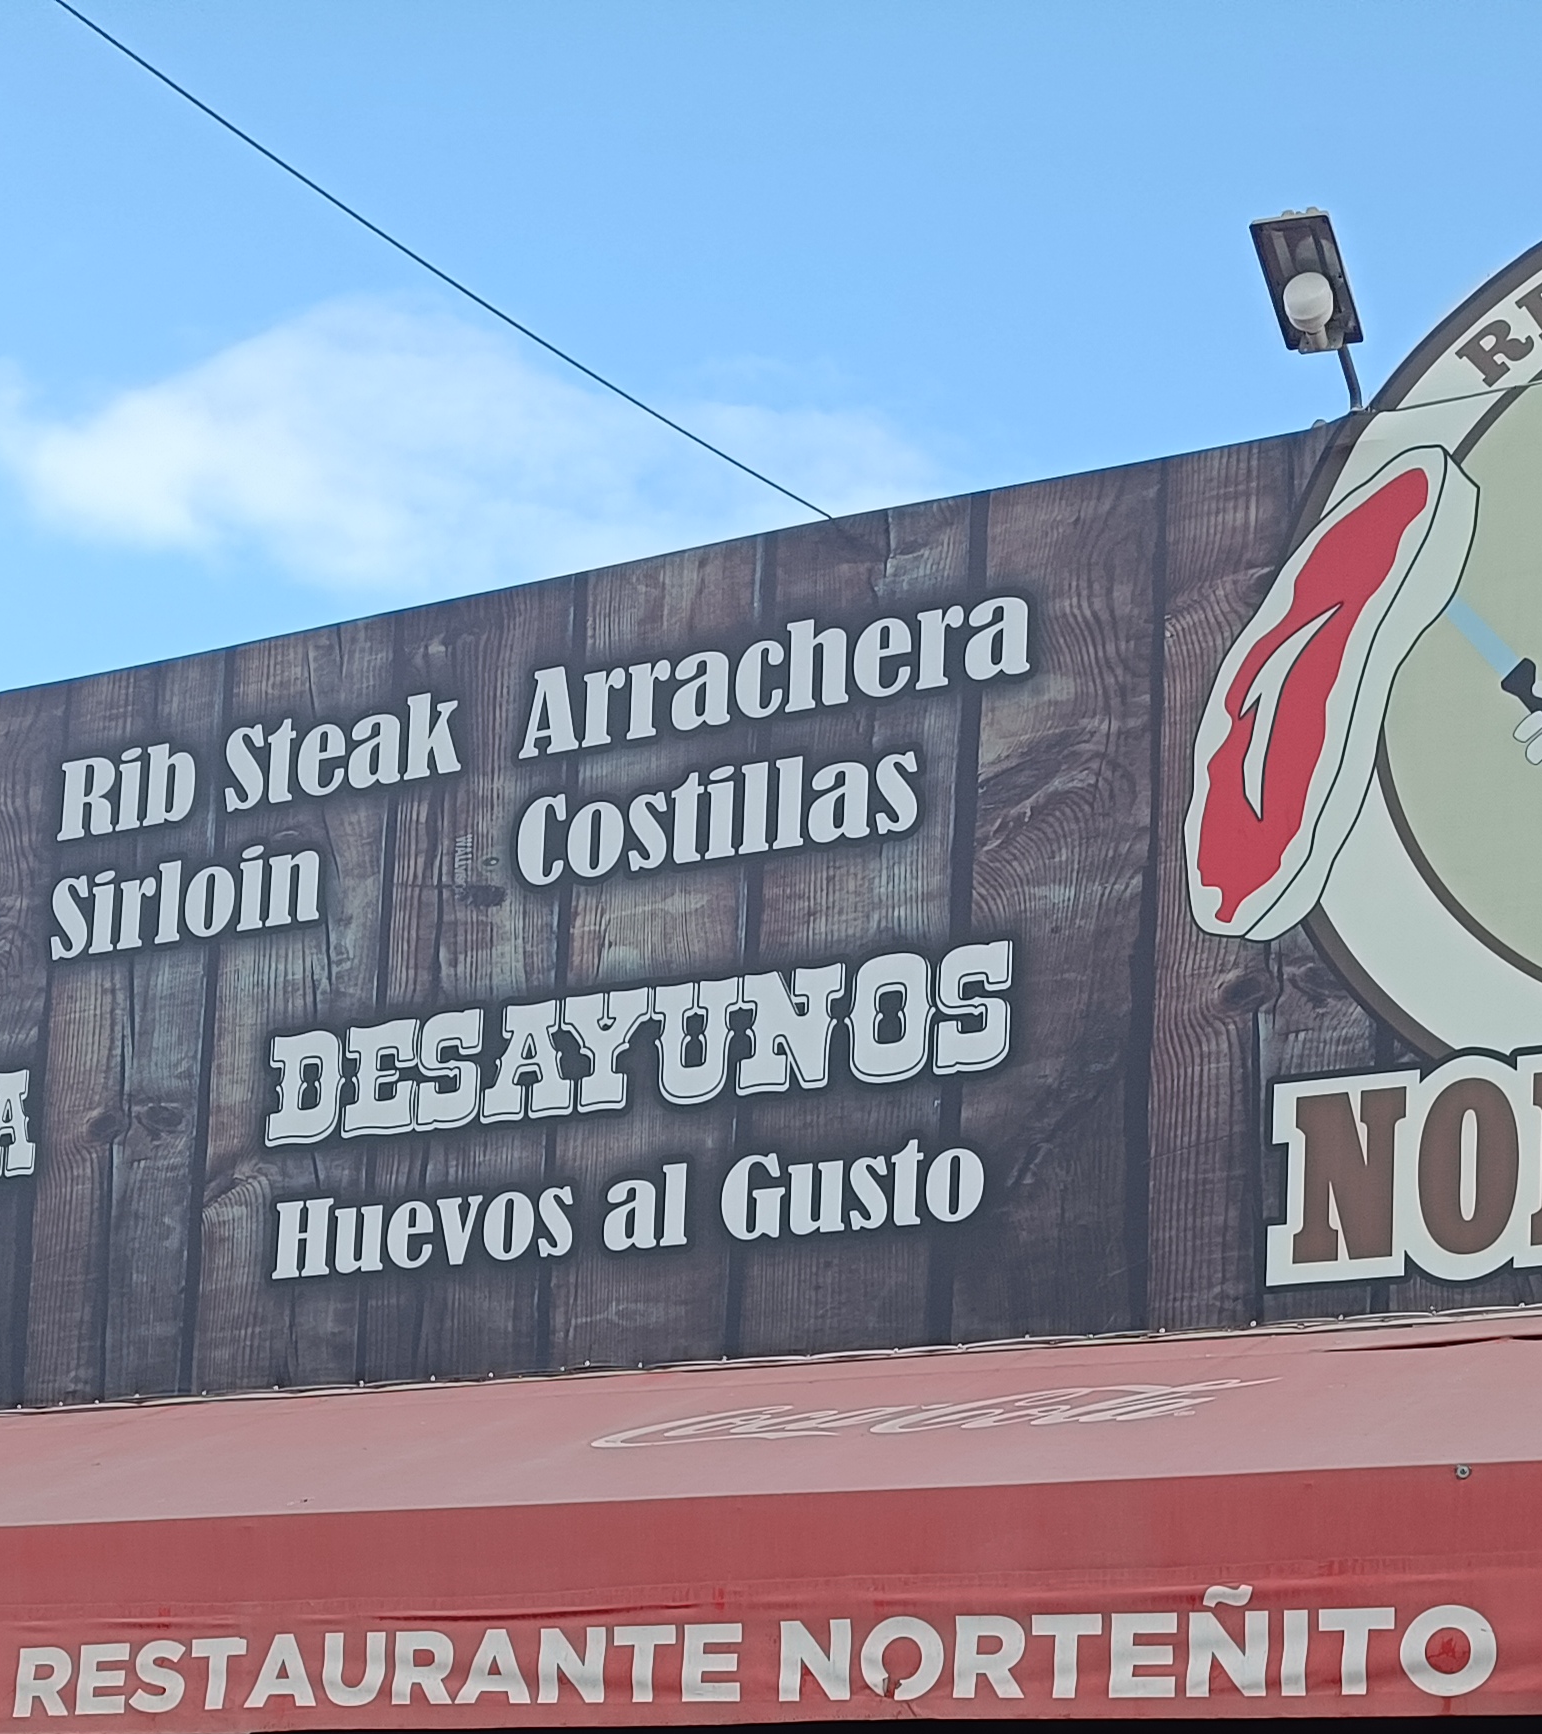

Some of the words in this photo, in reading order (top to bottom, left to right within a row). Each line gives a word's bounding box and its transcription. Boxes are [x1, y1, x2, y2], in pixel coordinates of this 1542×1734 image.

[518, 596, 1030, 760] Arrachera
[56, 746, 196, 842] Rib
[224, 693, 462, 813] Steak
[516, 751, 919, 886] Costillas
[49, 844, 321, 961] Sirloin
[264, 940, 1014, 1149] DESAYUNOS
[270, 1183, 574, 1280] Huevos
[601, 1163, 688, 1254] al
[720, 1139, 986, 1242] Gusto
[12, 1620, 742, 1718] RESTAURANTE
[779, 1582, 1498, 1701] NORTEÑITO
